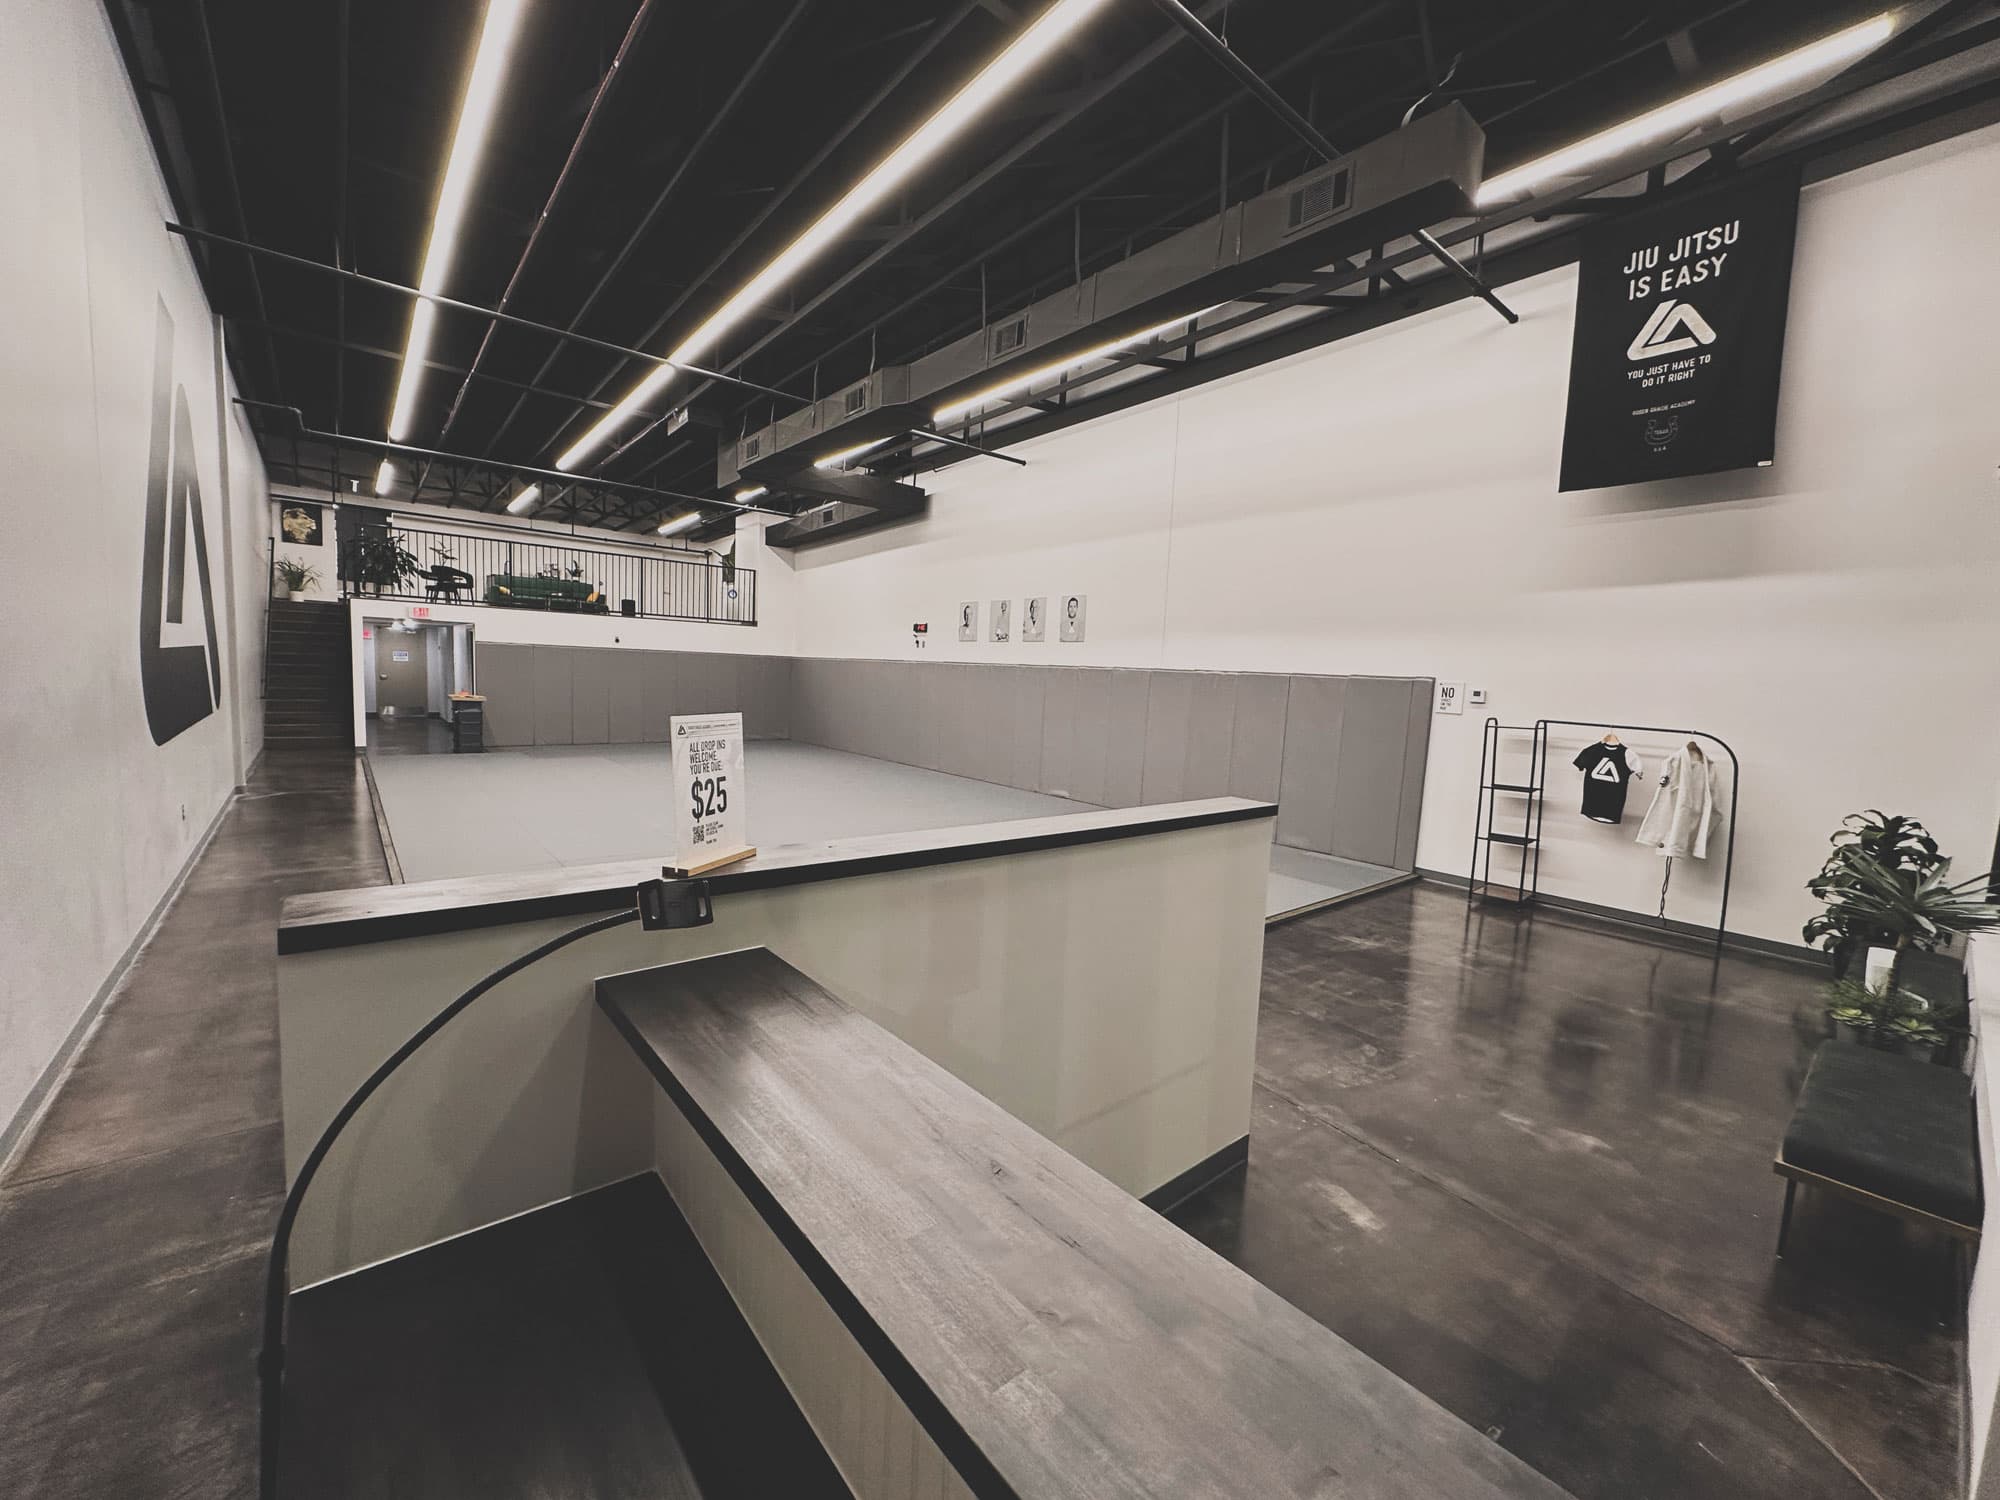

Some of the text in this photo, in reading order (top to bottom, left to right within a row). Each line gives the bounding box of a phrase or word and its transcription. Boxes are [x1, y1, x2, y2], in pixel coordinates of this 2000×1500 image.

[1624, 220, 1739, 274] JIU JITSU
[1629, 252, 1728, 301] IS EASY
[1627, 354, 1711, 380] YOU JUST HAVE TO
[1642, 369, 1696, 388] DO IT RIGHT
[413, 607, 429, 617] EXIT
[1441, 687, 1455, 698] NO
[689, 739, 726, 753] ALL DROP INS
[691, 776, 727, 823] $25
